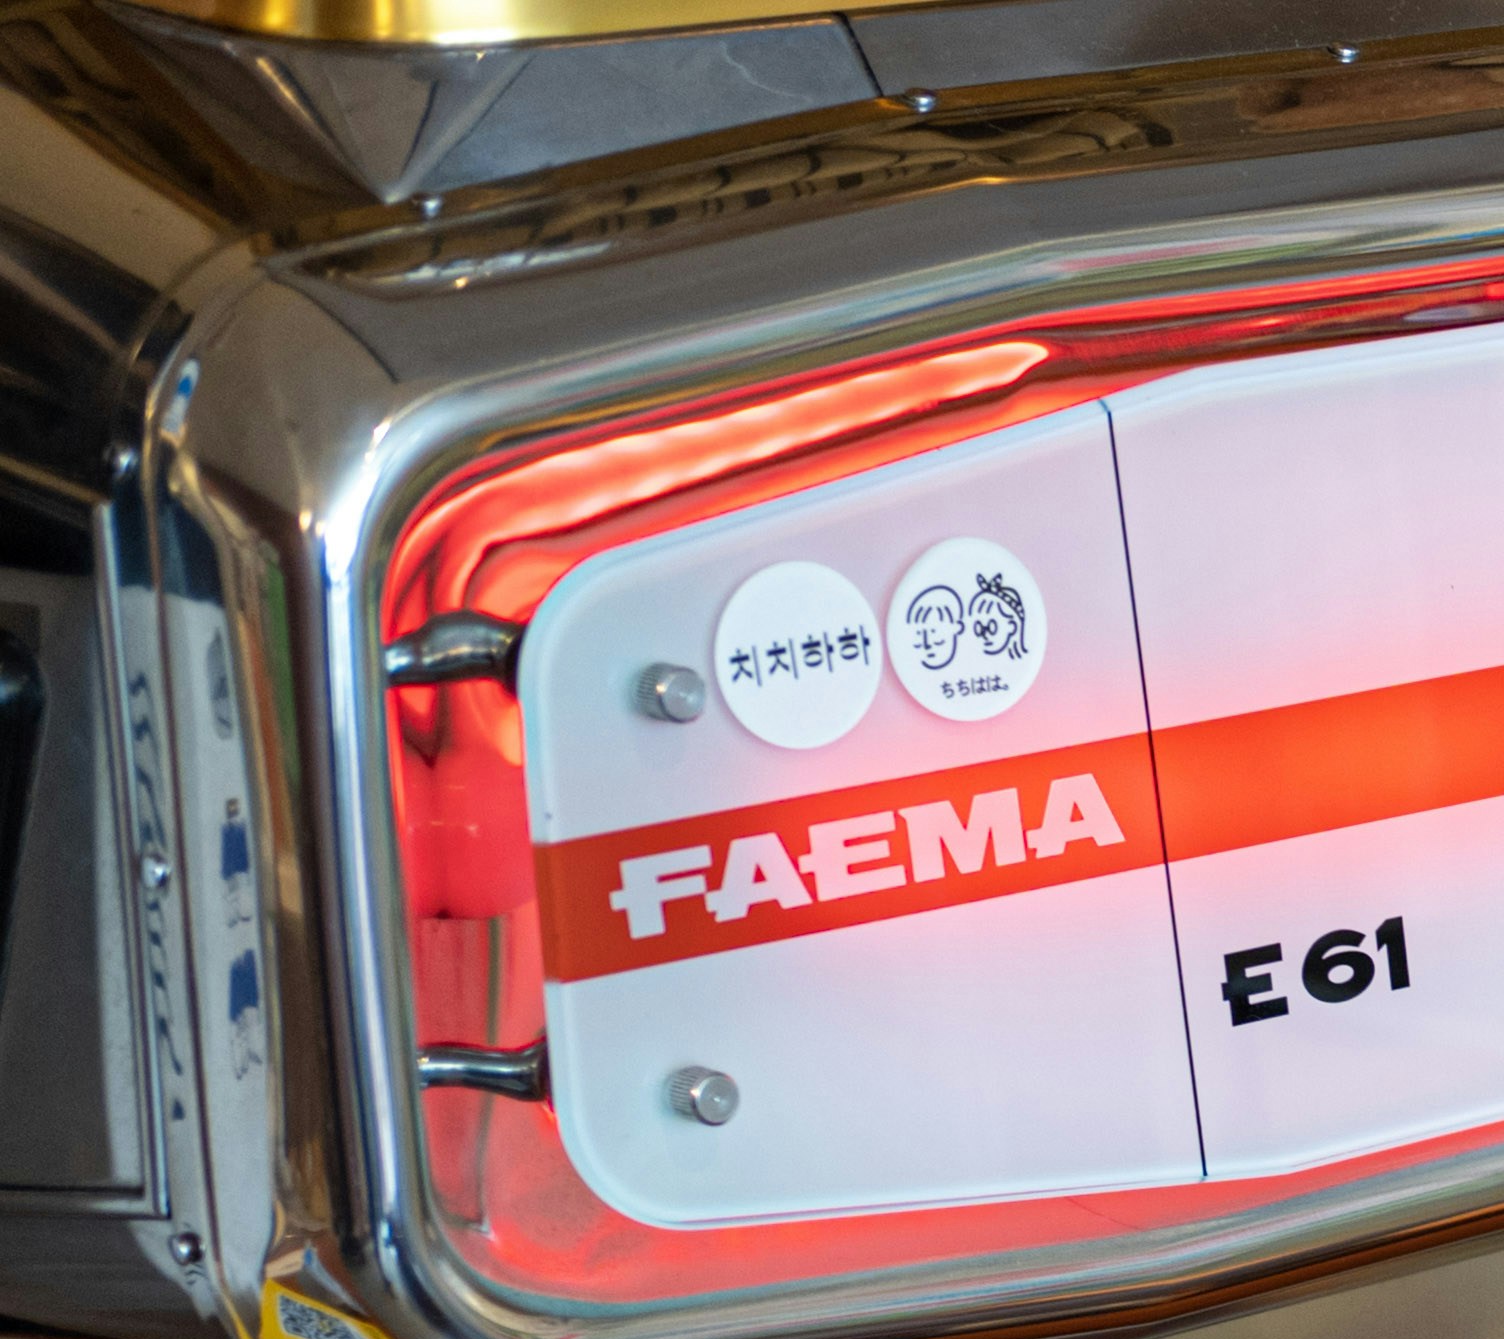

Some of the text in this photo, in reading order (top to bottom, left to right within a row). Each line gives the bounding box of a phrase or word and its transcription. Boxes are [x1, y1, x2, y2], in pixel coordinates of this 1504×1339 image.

[729, 625, 871, 687] 치치하하
[940, 674, 1010, 699] ちちはは。
[609, 773, 1126, 940] FAEMA
